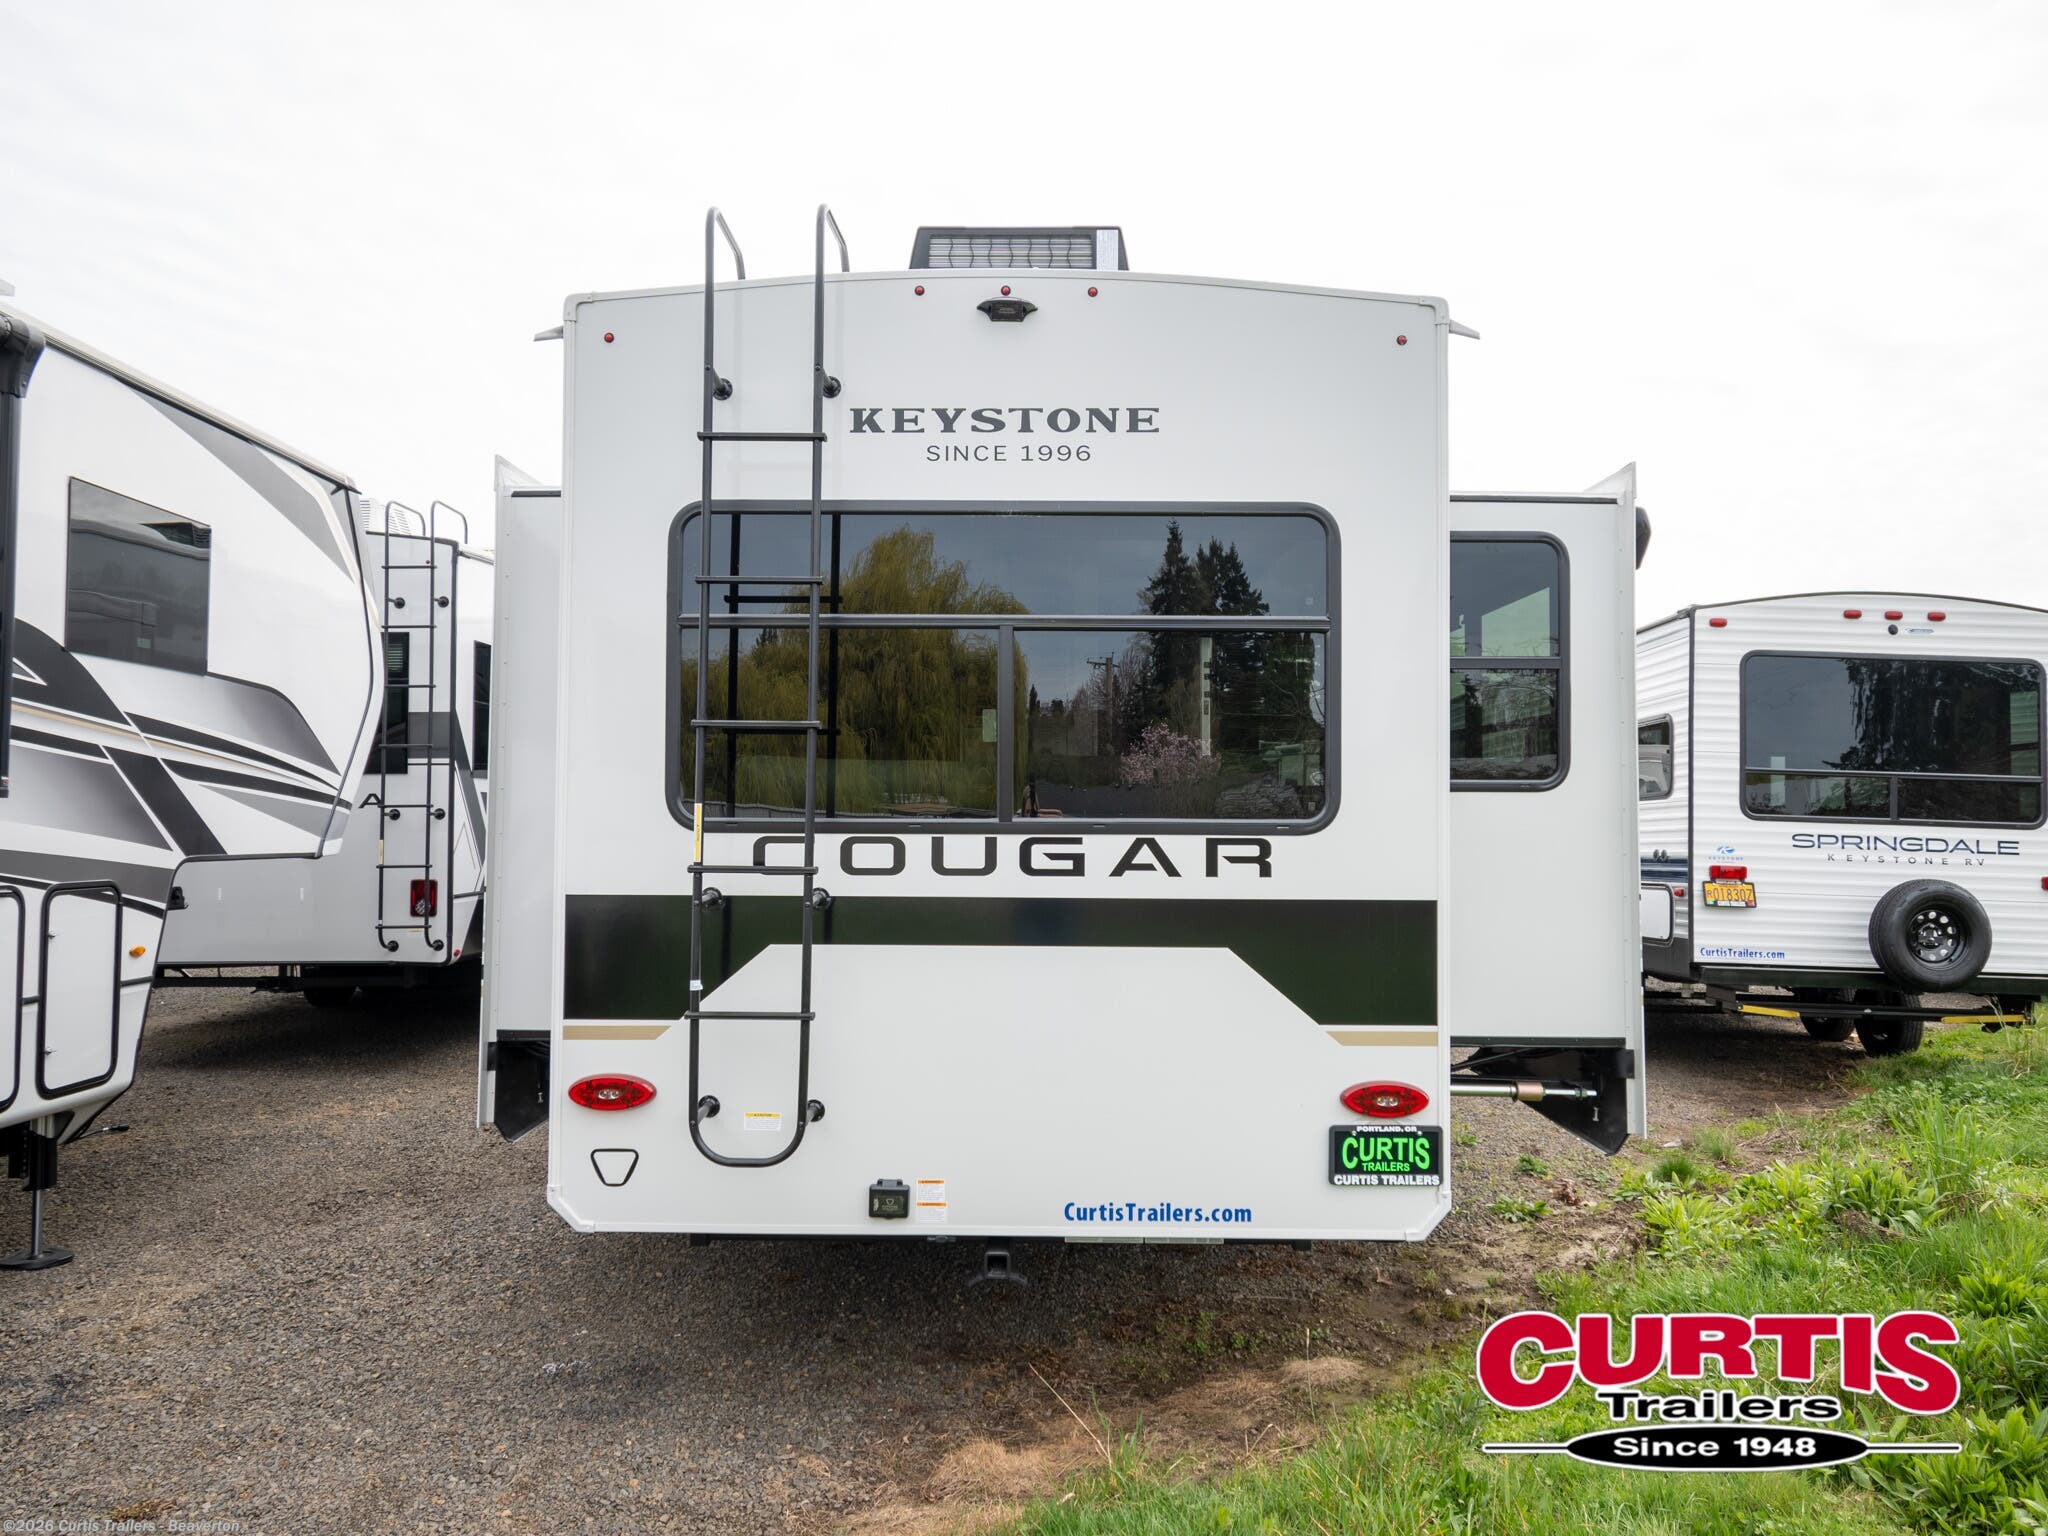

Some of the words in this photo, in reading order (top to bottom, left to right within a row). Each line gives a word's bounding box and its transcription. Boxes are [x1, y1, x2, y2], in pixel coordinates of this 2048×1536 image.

[850, 408, 1160, 434] KEYSTONE
[926, 445, 1007, 462] SINCE
[1020, 445, 1091, 462] 1996
[1791, 833, 2020, 856] SPRINGDALE
[753, 835, 1272, 878] COUGAR
[1827, 853, 1950, 866] KEYSTONE
[1964, 858, 1985, 867] RV
[1700, 947, 1785, 959] CurtisTrailers.com
[1342, 1136, 1431, 1170] CURTIS
[1362, 1162, 1411, 1172] TRAILERS
[1334, 1175, 1379, 1186] CURTIS
[1381, 1175, 1440, 1186] TRAILERS
[1064, 1202, 1253, 1223] CurtisTrailers.com
